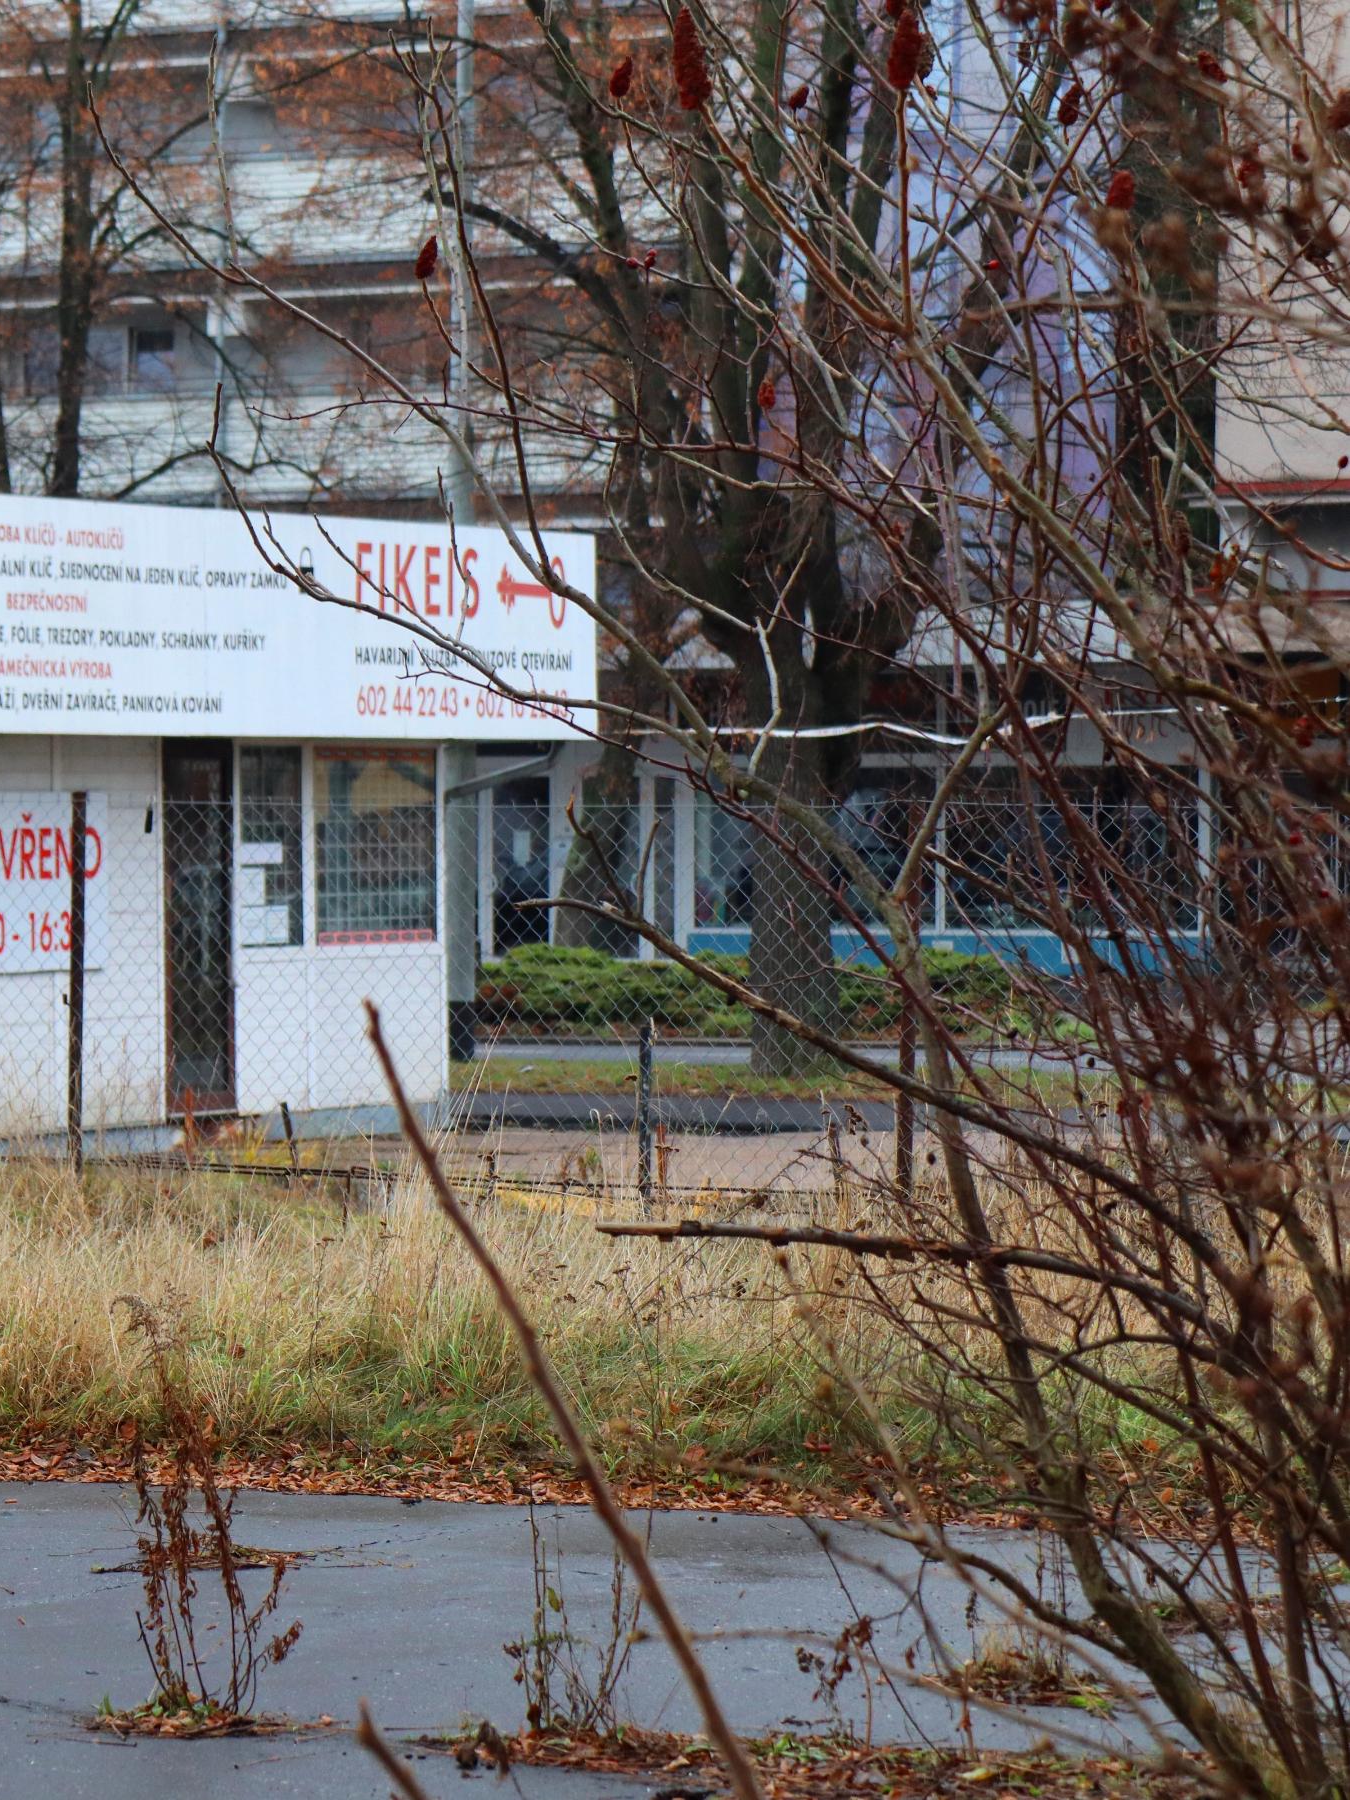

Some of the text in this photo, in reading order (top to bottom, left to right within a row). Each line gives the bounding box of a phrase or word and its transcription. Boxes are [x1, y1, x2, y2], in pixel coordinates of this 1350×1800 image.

[59, 560, 124, 584] SJEDNOCENÍ
[126, 567, 141, 584] NA
[144, 567, 175, 586] JEDEN
[205, 568, 248, 589] OPRAVY
[354, 541, 480, 619] FIKEIS
[6, 588, 88, 614] BEZPEČNOSTNÍ
[47, 625, 97, 648] TREZORY,
[222, 628, 267, 651] KUFŘÍKY
[70, 656, 113, 680] VÝROBA
[122, 692, 179, 713] PANIKOVÁ
[181, 691, 223, 714] KOVÁNÍ
[356, 684, 388, 717] 602
[393, 685, 413, 716] 44
[416, 686, 437, 717] 22
[439, 687, 459, 717] 43
[28, 910, 74, 953] 16:3
